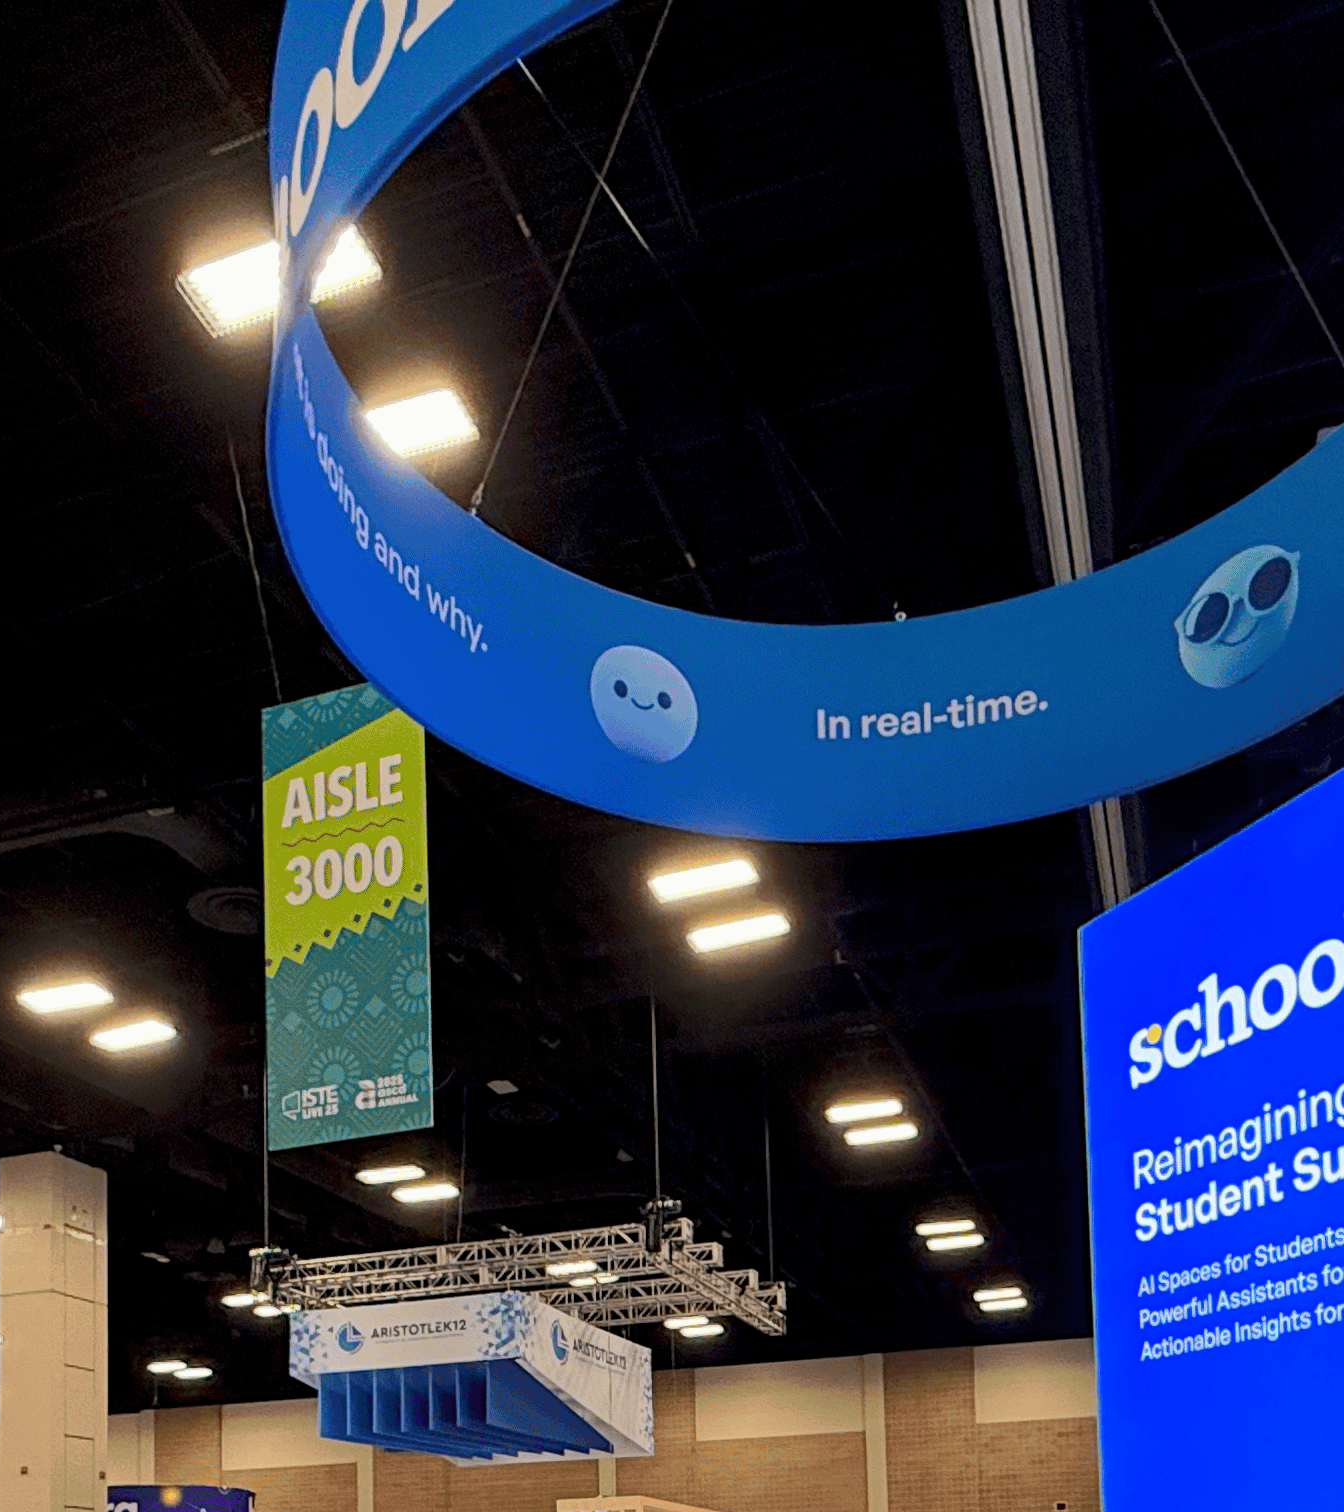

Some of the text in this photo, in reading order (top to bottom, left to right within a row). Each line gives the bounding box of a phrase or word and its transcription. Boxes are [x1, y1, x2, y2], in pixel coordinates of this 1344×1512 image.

[316, 431, 488, 652] doing and why.
[817, 688, 1050, 740] In real-time.
[281, 753, 403, 828] AISLE
[284, 835, 403, 906] 3000
[301, 1084, 339, 1107] ISTE
[1134, 1162, 1284, 1242] Student
[1138, 1276, 1155, 1297] AI
[1158, 1264, 1222, 1292] Spaces
[1224, 1255, 1251, 1276] for
[1139, 1298, 1213, 1329] Powerful
[1217, 1275, 1318, 1311] Assistants
[371, 1319, 467, 1339] ARISTOTLEK12
[1140, 1326, 1231, 1361] Actionable
[1234, 1309, 1312, 1346] Insights
[1315, 1300, 1344, 1325] for
